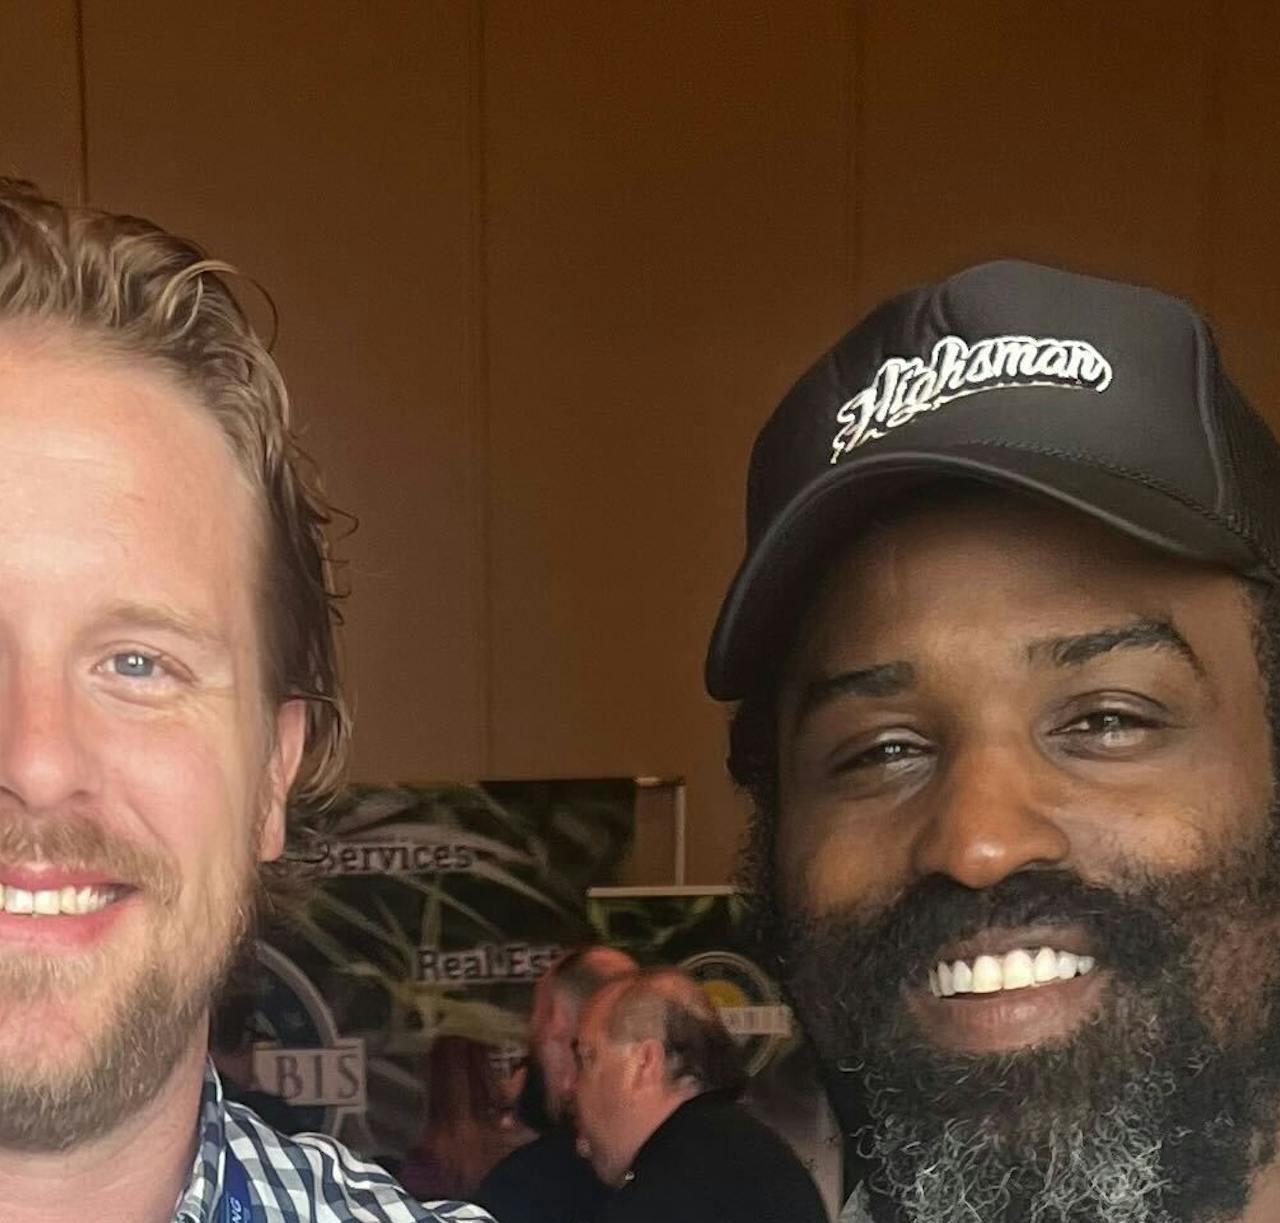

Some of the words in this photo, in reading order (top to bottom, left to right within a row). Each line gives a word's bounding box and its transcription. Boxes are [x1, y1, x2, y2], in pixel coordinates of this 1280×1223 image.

[831, 336, 1112, 464] Highsman
[417, 946, 493, 981] Real
[276, 1055, 360, 1099] BIS
